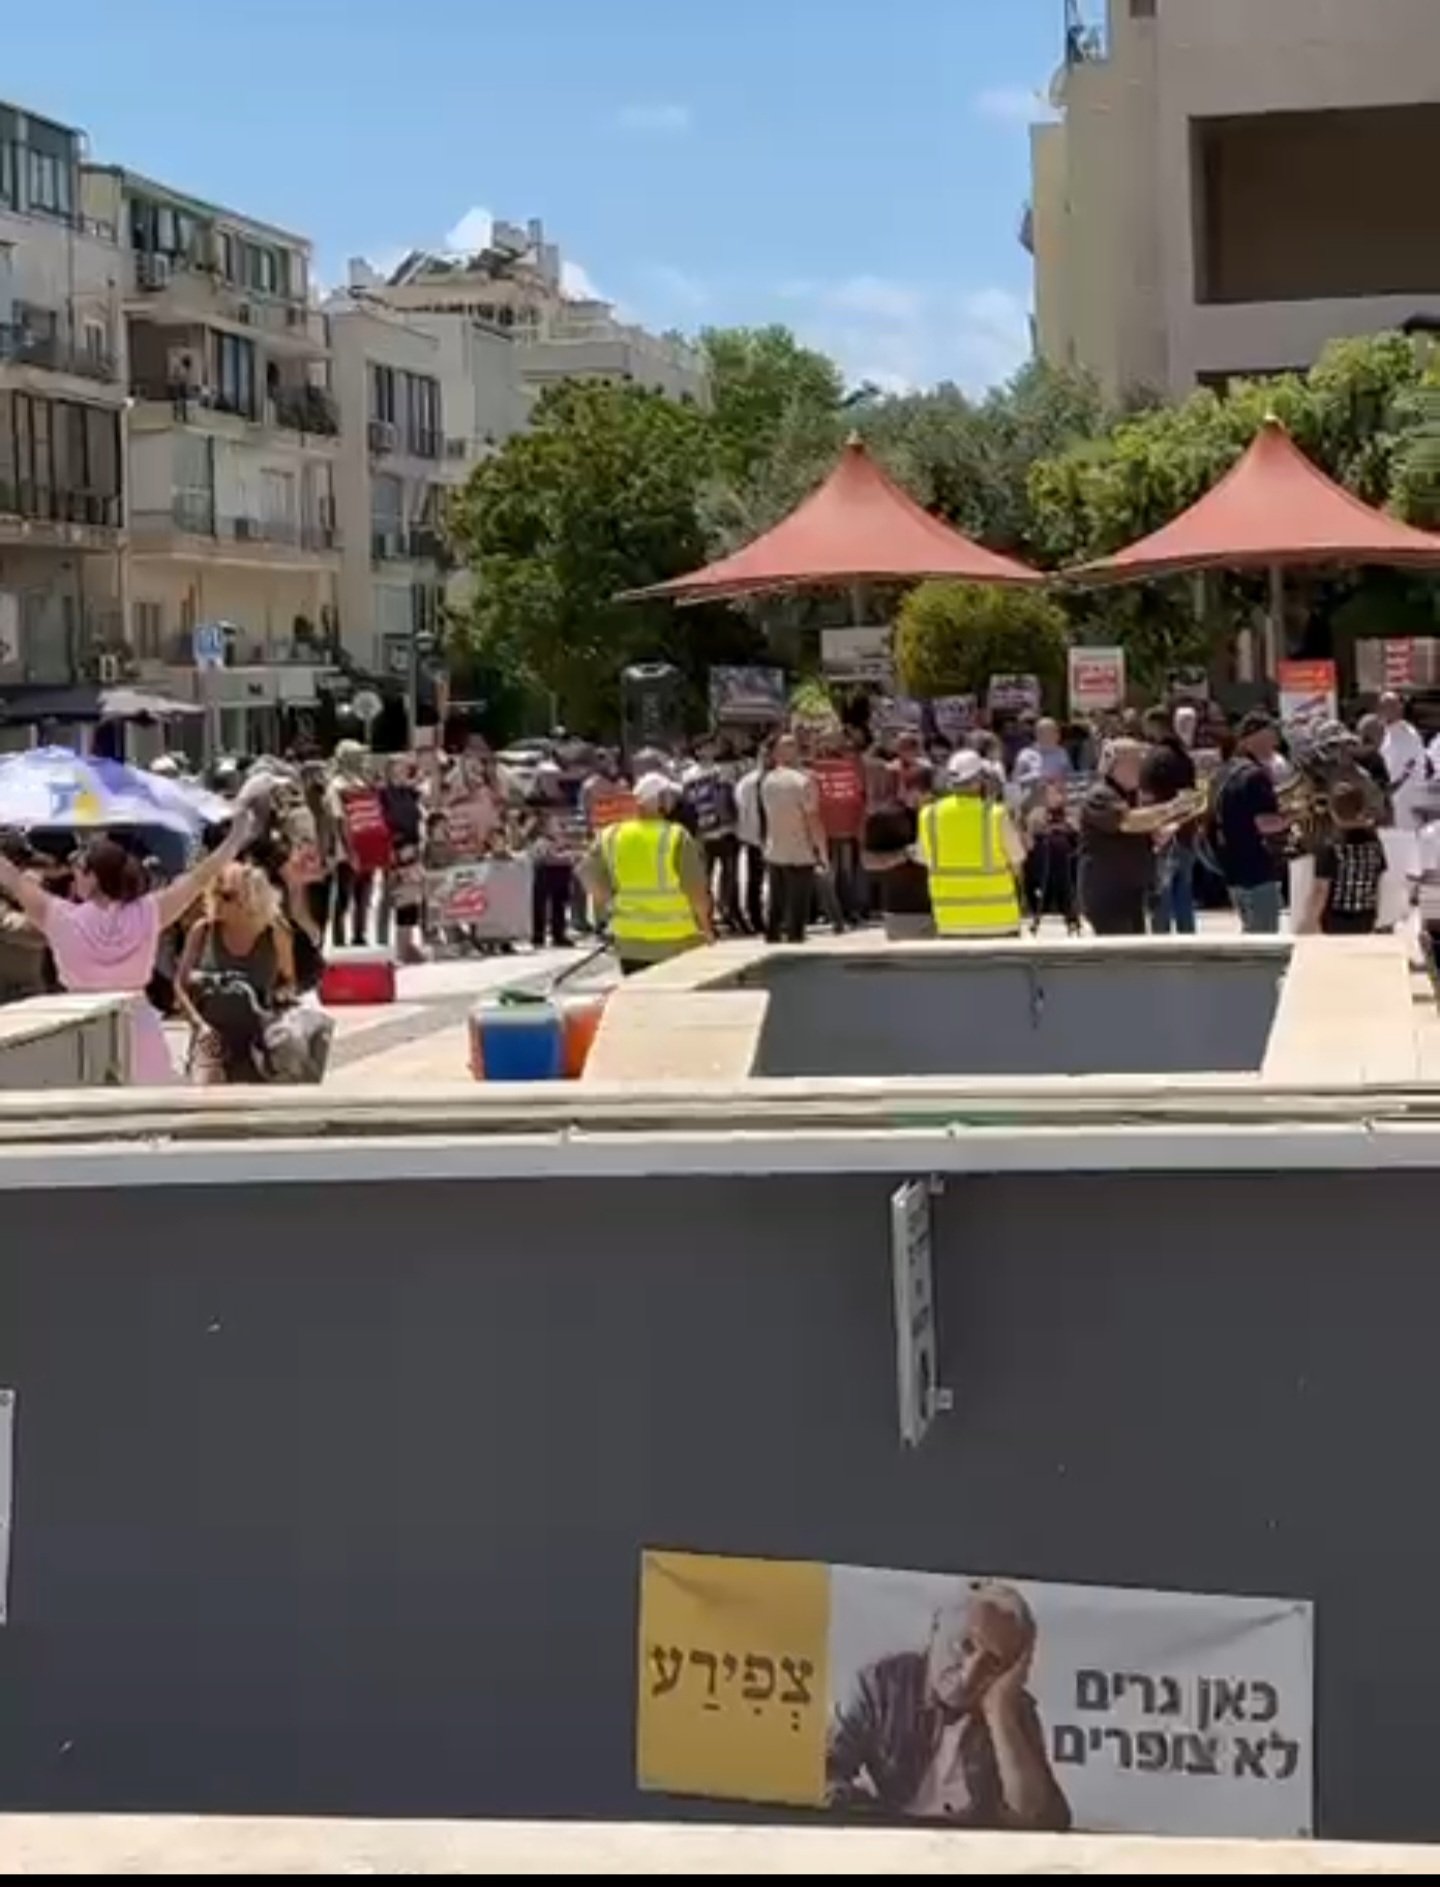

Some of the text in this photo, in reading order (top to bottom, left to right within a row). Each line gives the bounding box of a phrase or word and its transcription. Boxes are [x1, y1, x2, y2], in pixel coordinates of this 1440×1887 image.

[1075, 1669, 1279, 1731] כאן גרים
[1053, 1724, 1299, 1779] לא צופרים
